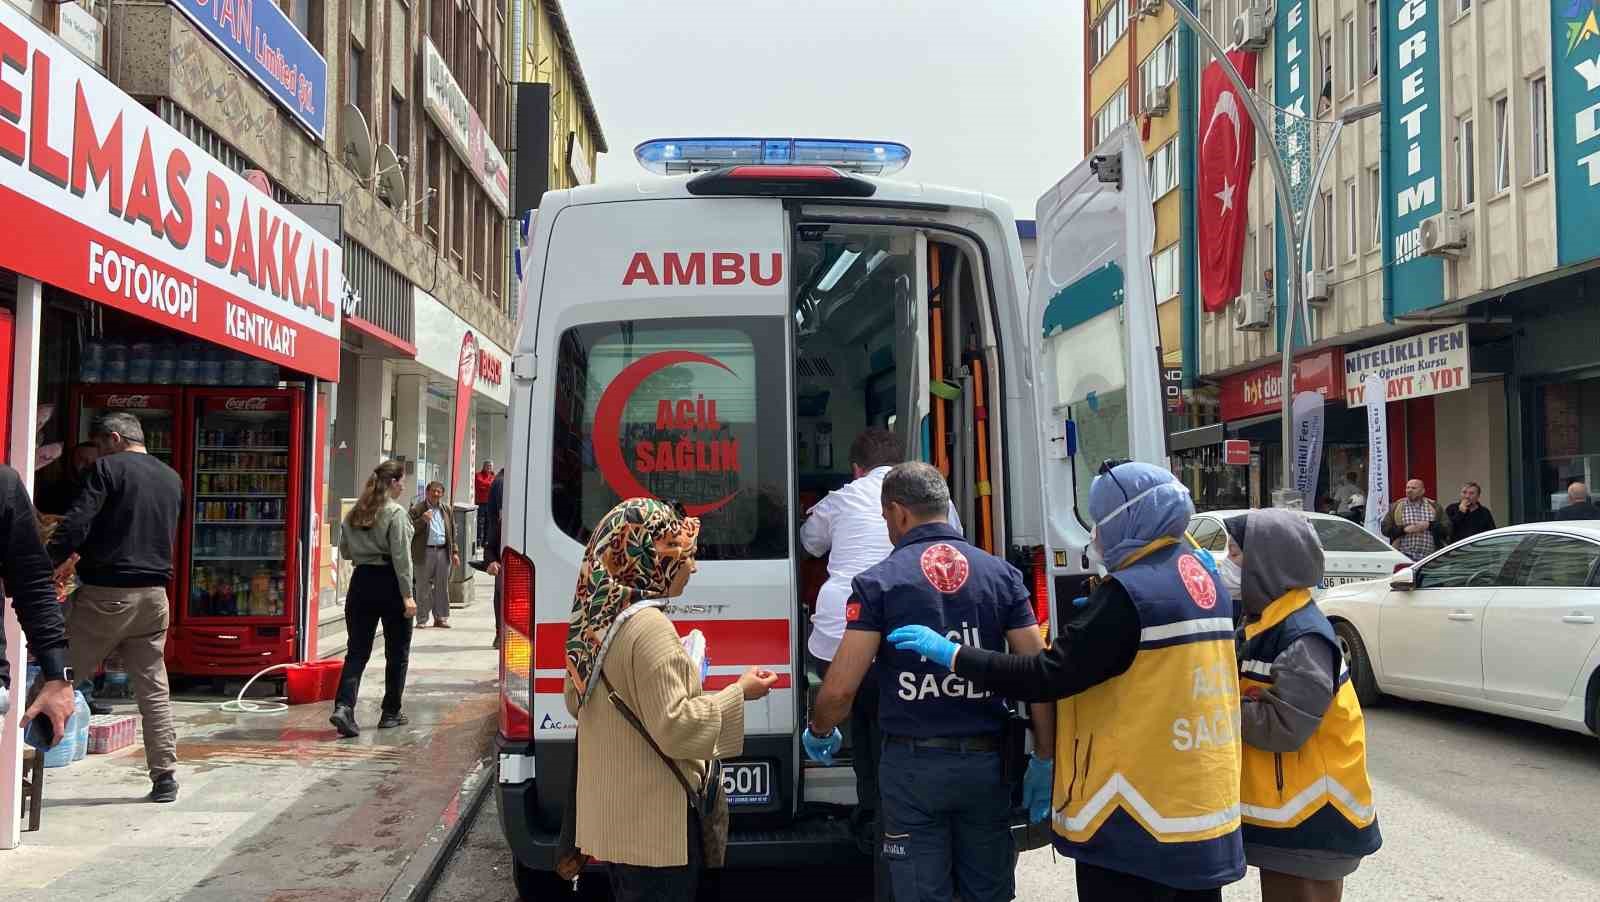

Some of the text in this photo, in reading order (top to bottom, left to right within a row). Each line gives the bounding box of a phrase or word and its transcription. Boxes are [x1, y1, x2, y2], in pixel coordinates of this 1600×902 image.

[0, 23, 338, 324] ELMAS BAKKAL
[87, 240, 199, 324] FOTOKOPİ
[622, 252, 784, 286] AMBU
[225, 301, 297, 359] KENTKART
[1345, 331, 1464, 374] NİTELİKLİ FEN
[1418, 357, 1448, 371] Kursu
[1348, 385, 1366, 406] TY
[1387, 376, 1415, 399] AYT
[1430, 367, 1464, 391] YDT
[636, 436, 742, 473] SAĞLIK
[898, 672, 990, 701] SAĞL
[721, 766, 762, 794] 501
